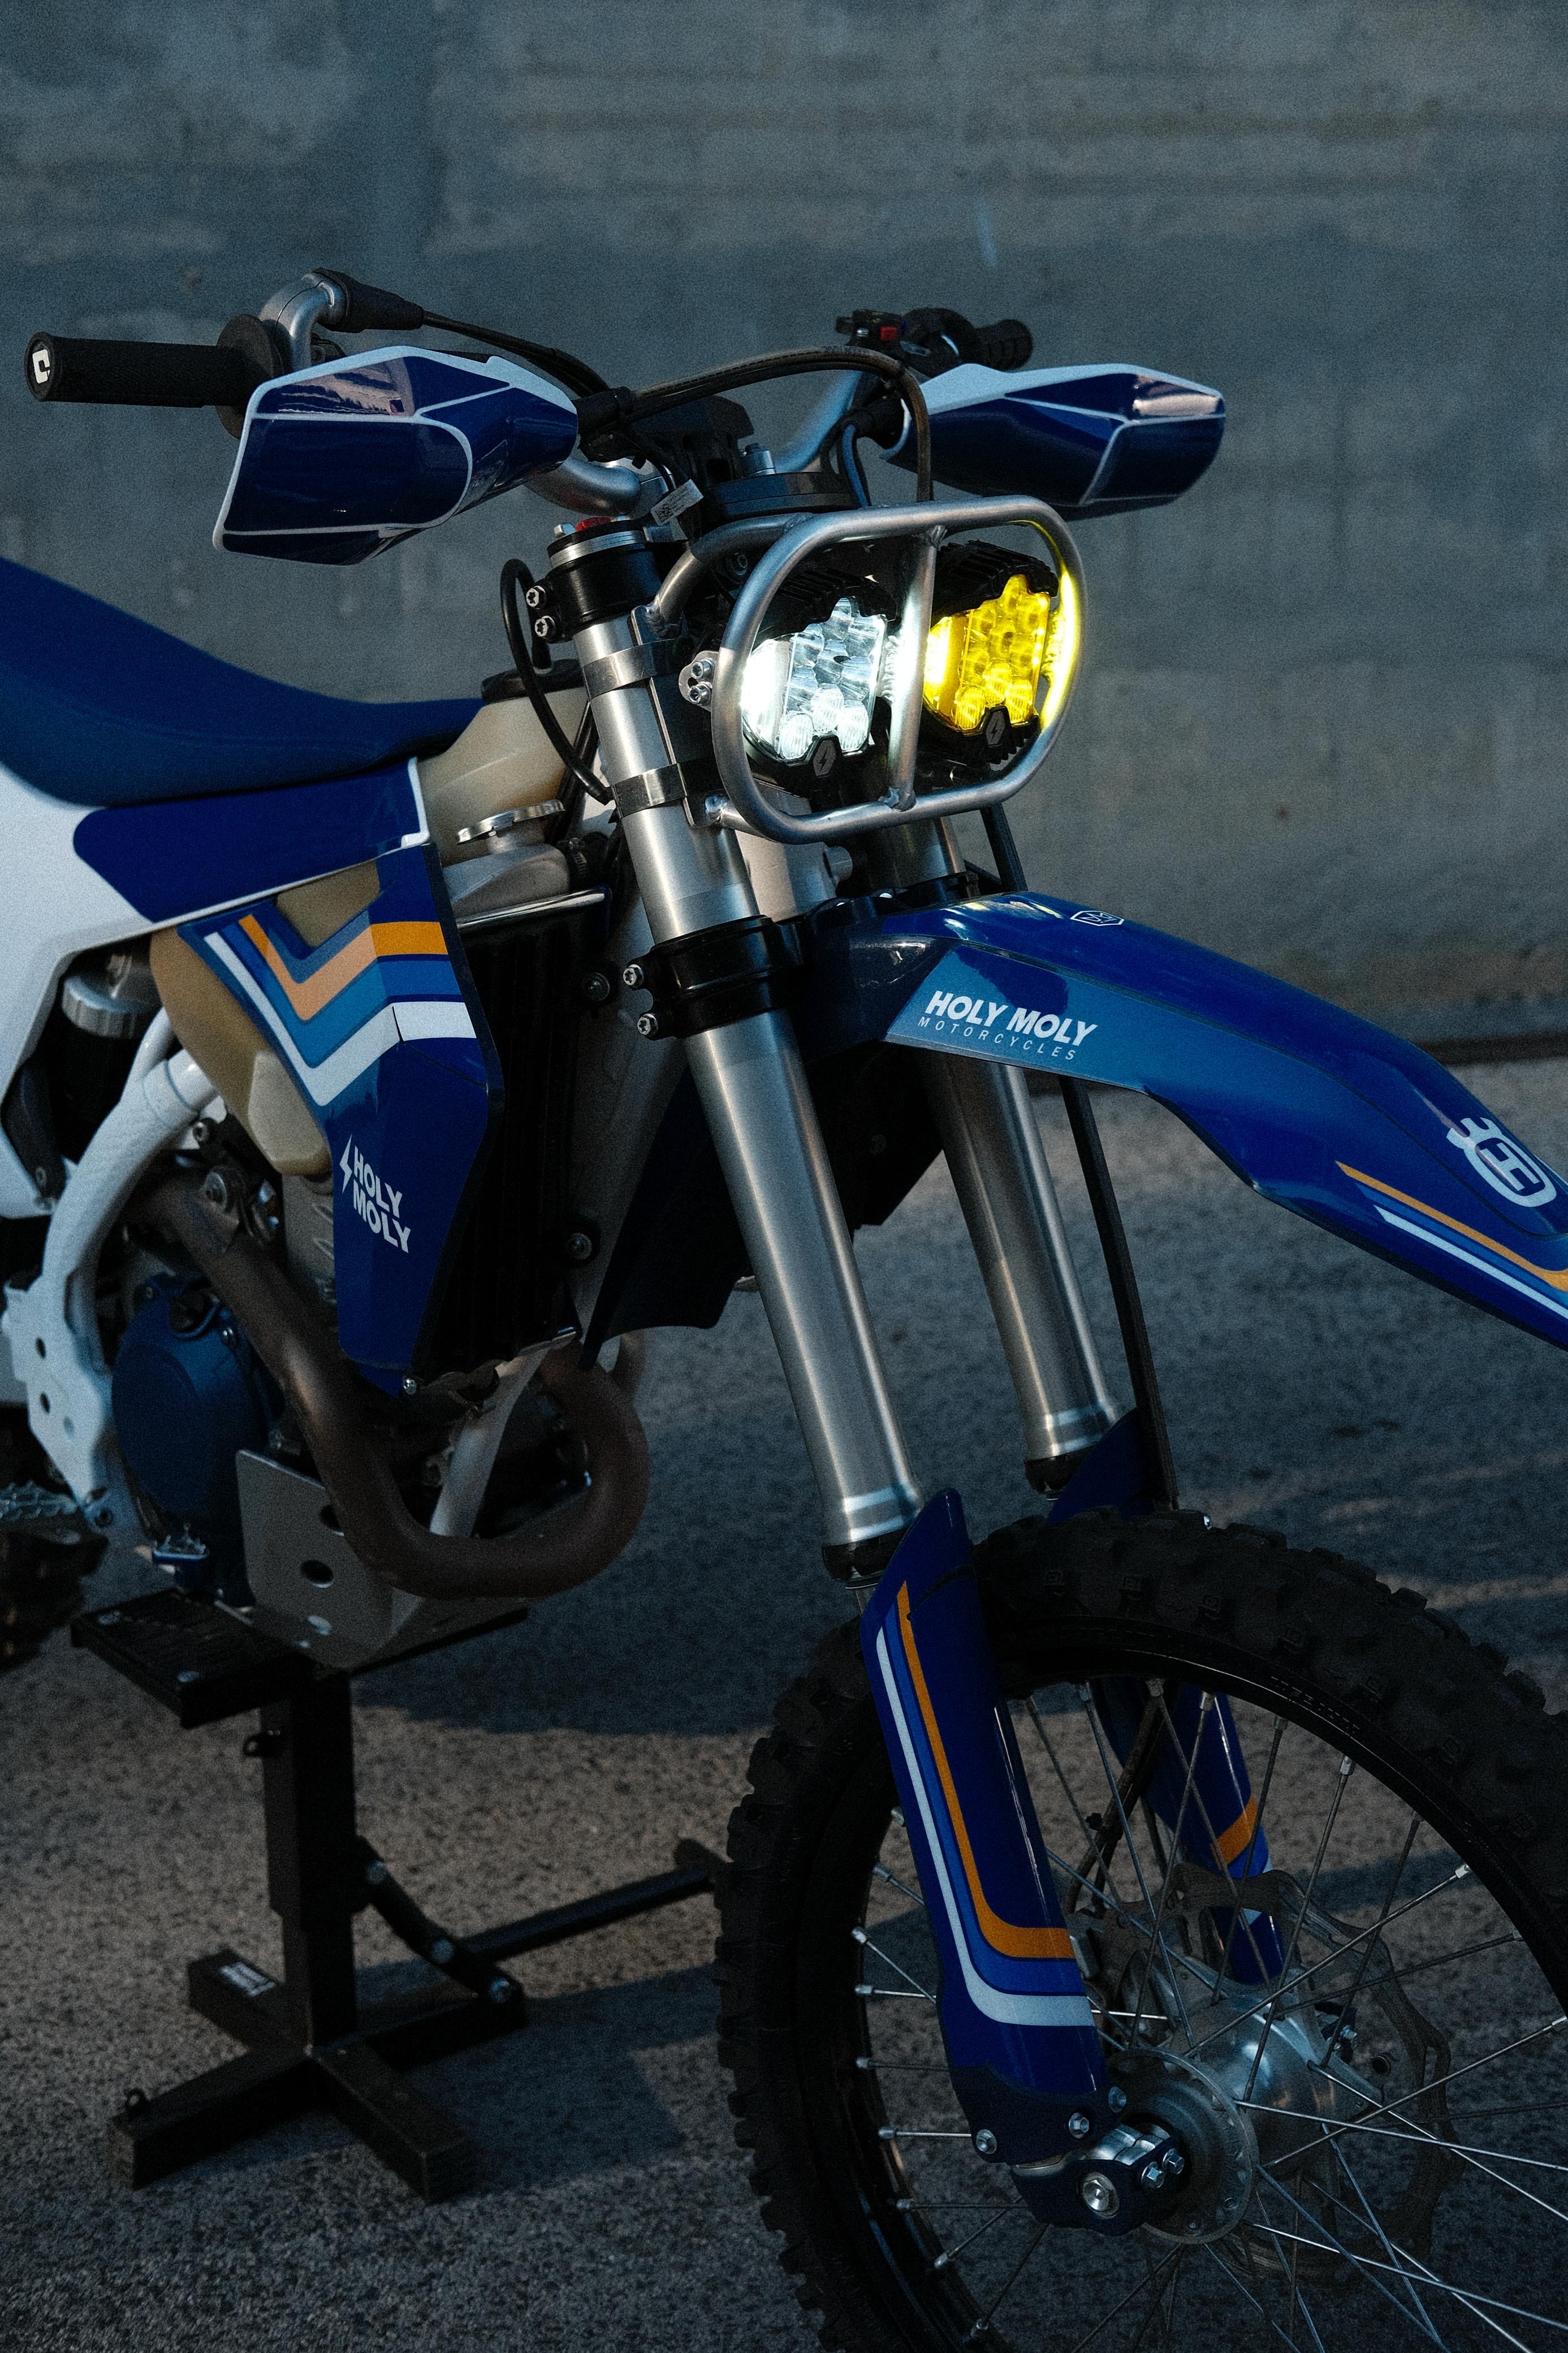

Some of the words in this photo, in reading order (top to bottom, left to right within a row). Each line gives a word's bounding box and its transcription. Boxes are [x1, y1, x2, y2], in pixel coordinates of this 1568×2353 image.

[918, 1016, 1076, 1060] MOTORCYCLES
[925, 991, 1008, 1027] HOLY
[1007, 1007, 1098, 1046] MOLY
[354, 1145, 403, 1218] HOLY
[353, 1179, 411, 1253] MOLY
